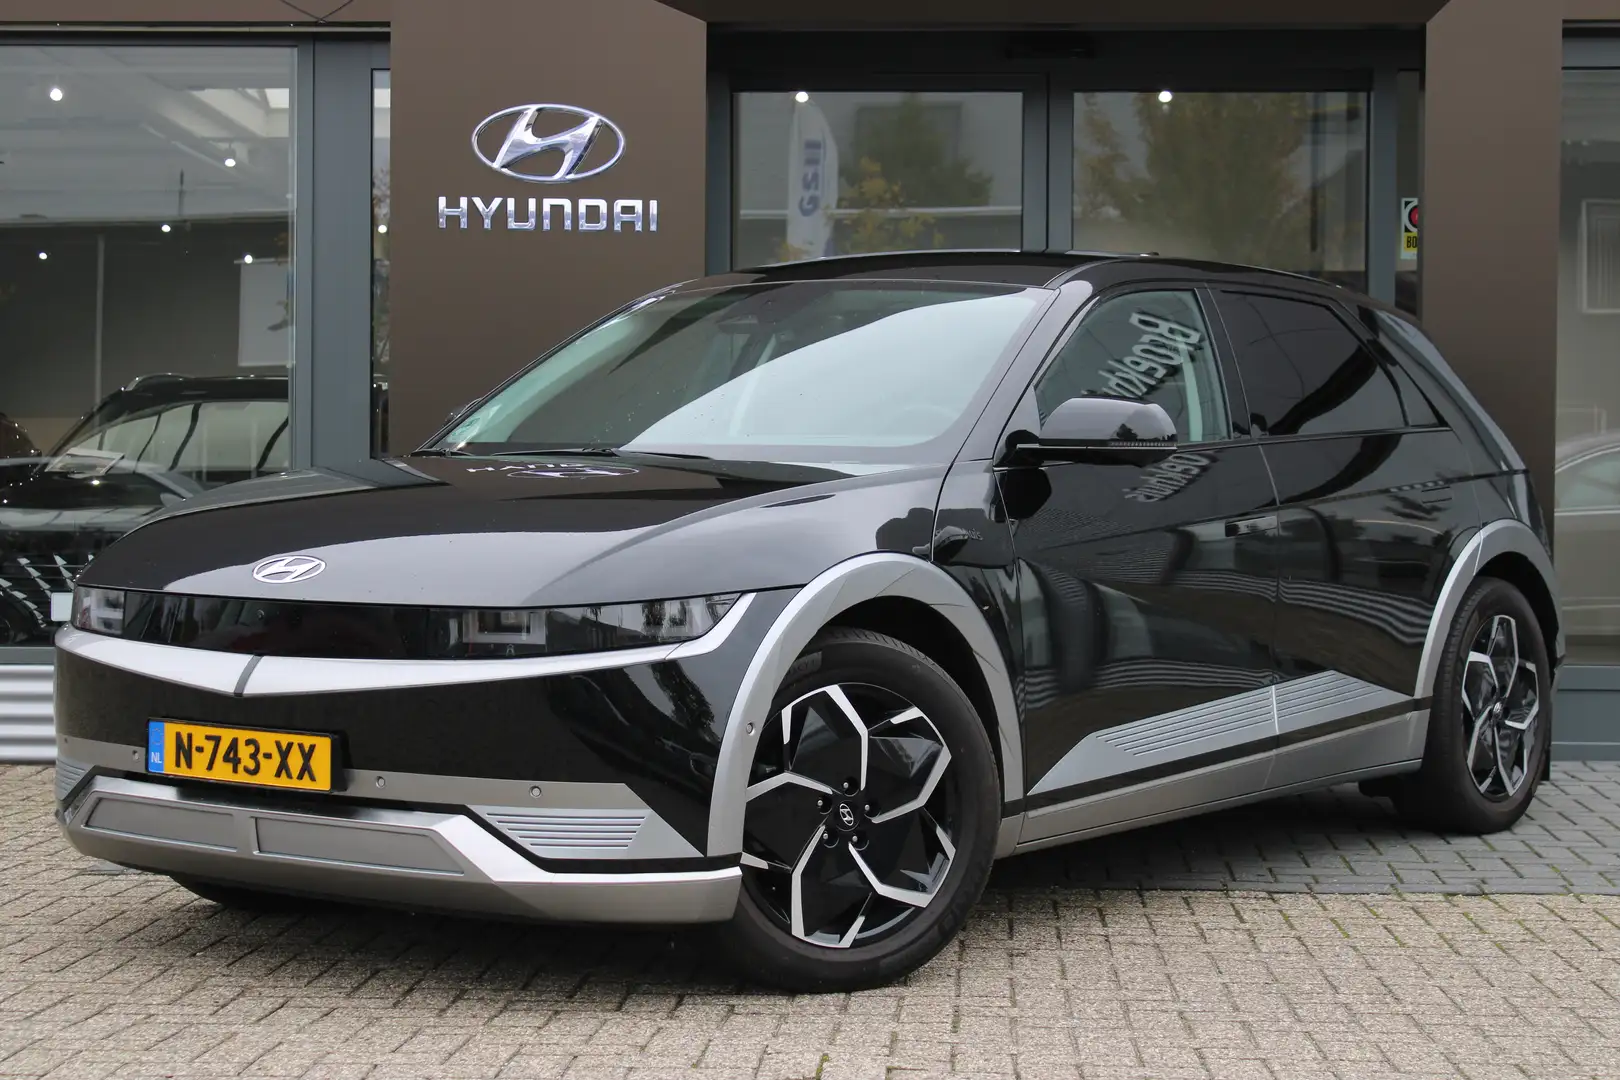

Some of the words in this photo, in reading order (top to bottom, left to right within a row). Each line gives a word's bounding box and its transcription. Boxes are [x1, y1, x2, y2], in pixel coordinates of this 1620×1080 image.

[438, 196, 658, 232] HYUNDAI
[150, 751, 163, 764] NL
[174, 731, 317, 782] N-743-XX
